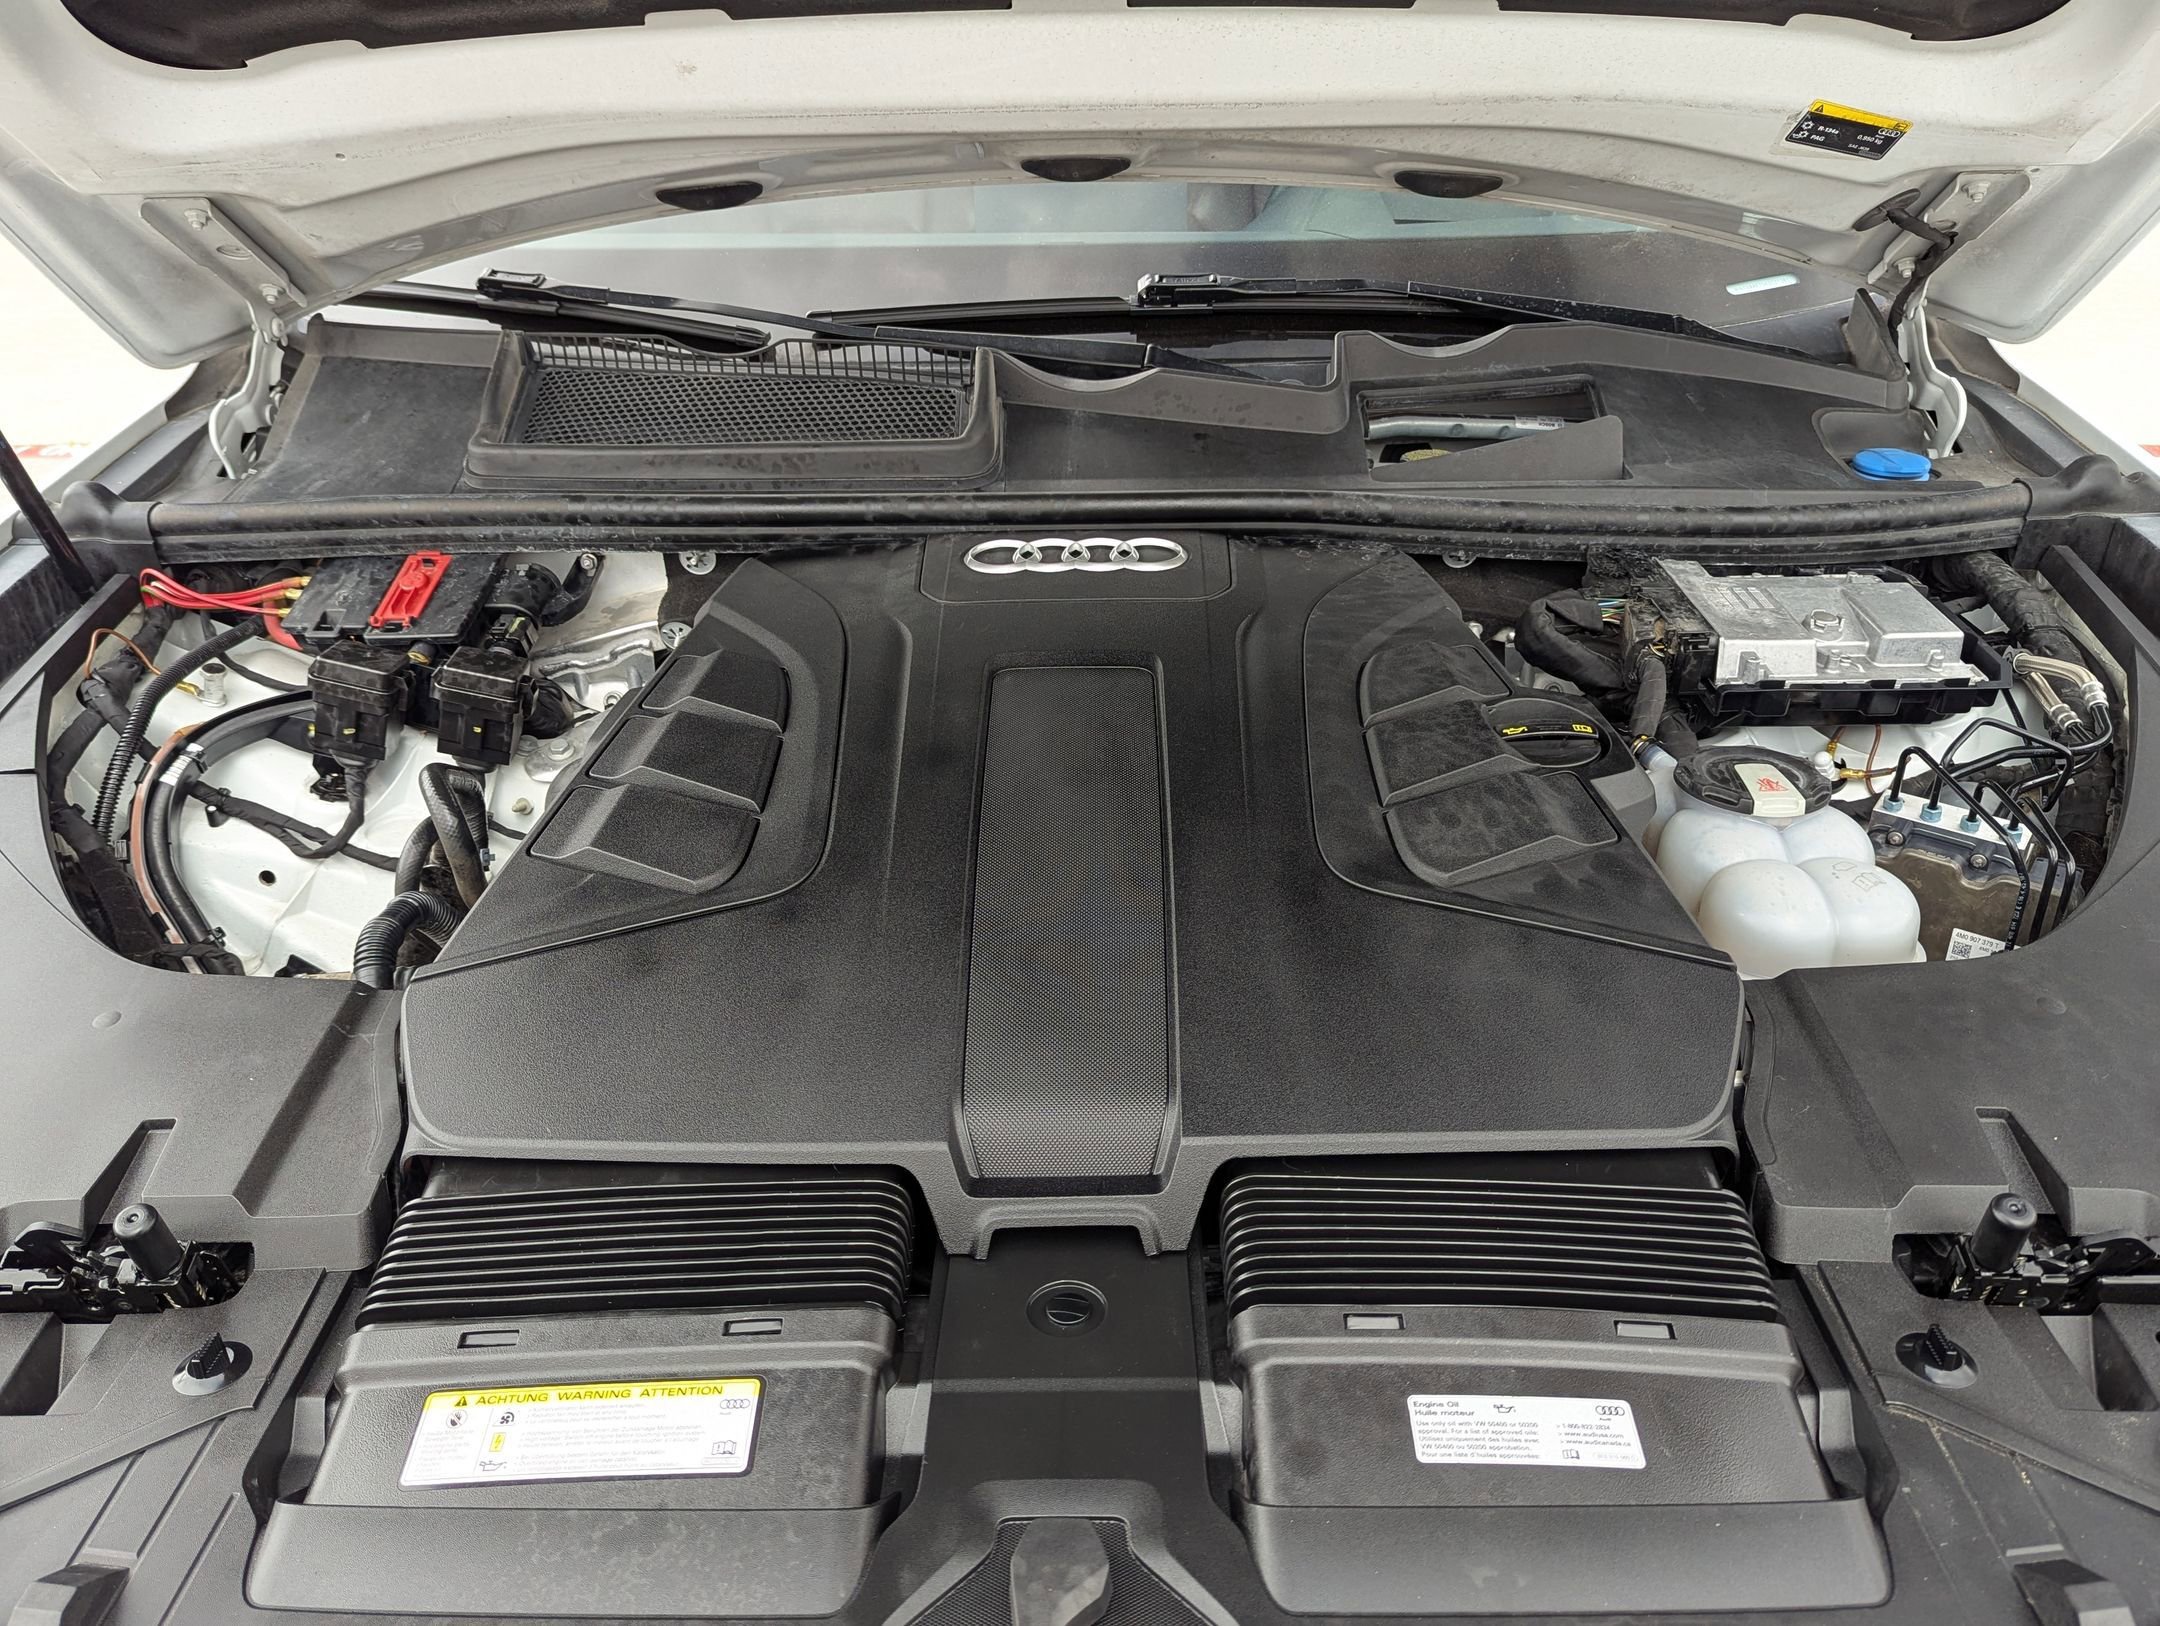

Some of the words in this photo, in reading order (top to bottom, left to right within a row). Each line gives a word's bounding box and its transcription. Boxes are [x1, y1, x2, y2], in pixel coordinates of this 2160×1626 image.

[1818, 126, 1839, 134] R-134a
[1874, 136, 1884, 144] kg
[1956, 932, 1969, 940] 4M0
[1970, 936, 1981, 944] 907
[1982, 939, 1994, 947] 379
[476, 1394, 548, 1406] ACHTUNG
[558, 1388, 631, 1401] WARNING
[640, 1386, 723, 1399] ATTENTION
